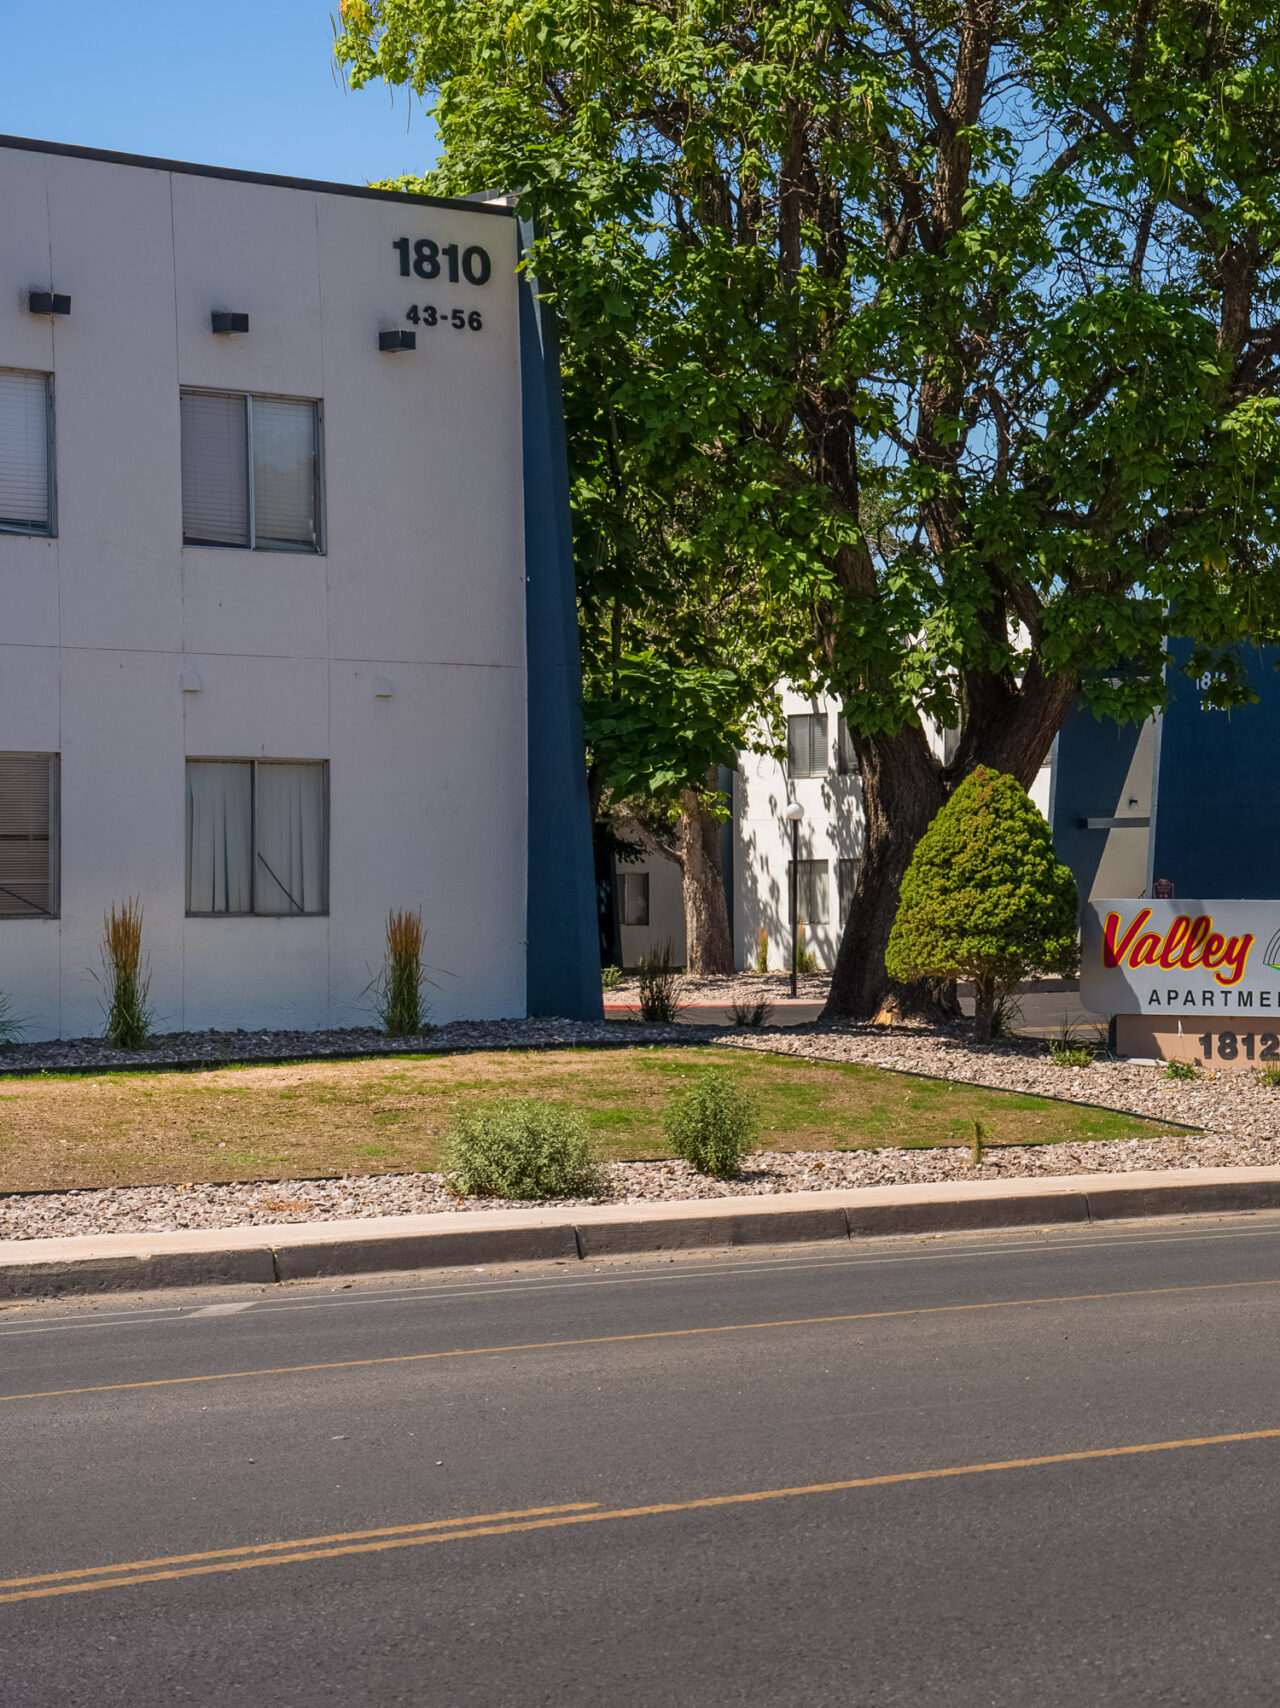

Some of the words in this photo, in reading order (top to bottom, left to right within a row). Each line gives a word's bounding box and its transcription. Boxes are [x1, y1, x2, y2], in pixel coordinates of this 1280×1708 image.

[392, 237, 491, 286] 1810
[405, 304, 483, 331] 43-56
[1102, 907, 1255, 987] Valley
[1199, 1031, 1280, 1062] 1812
